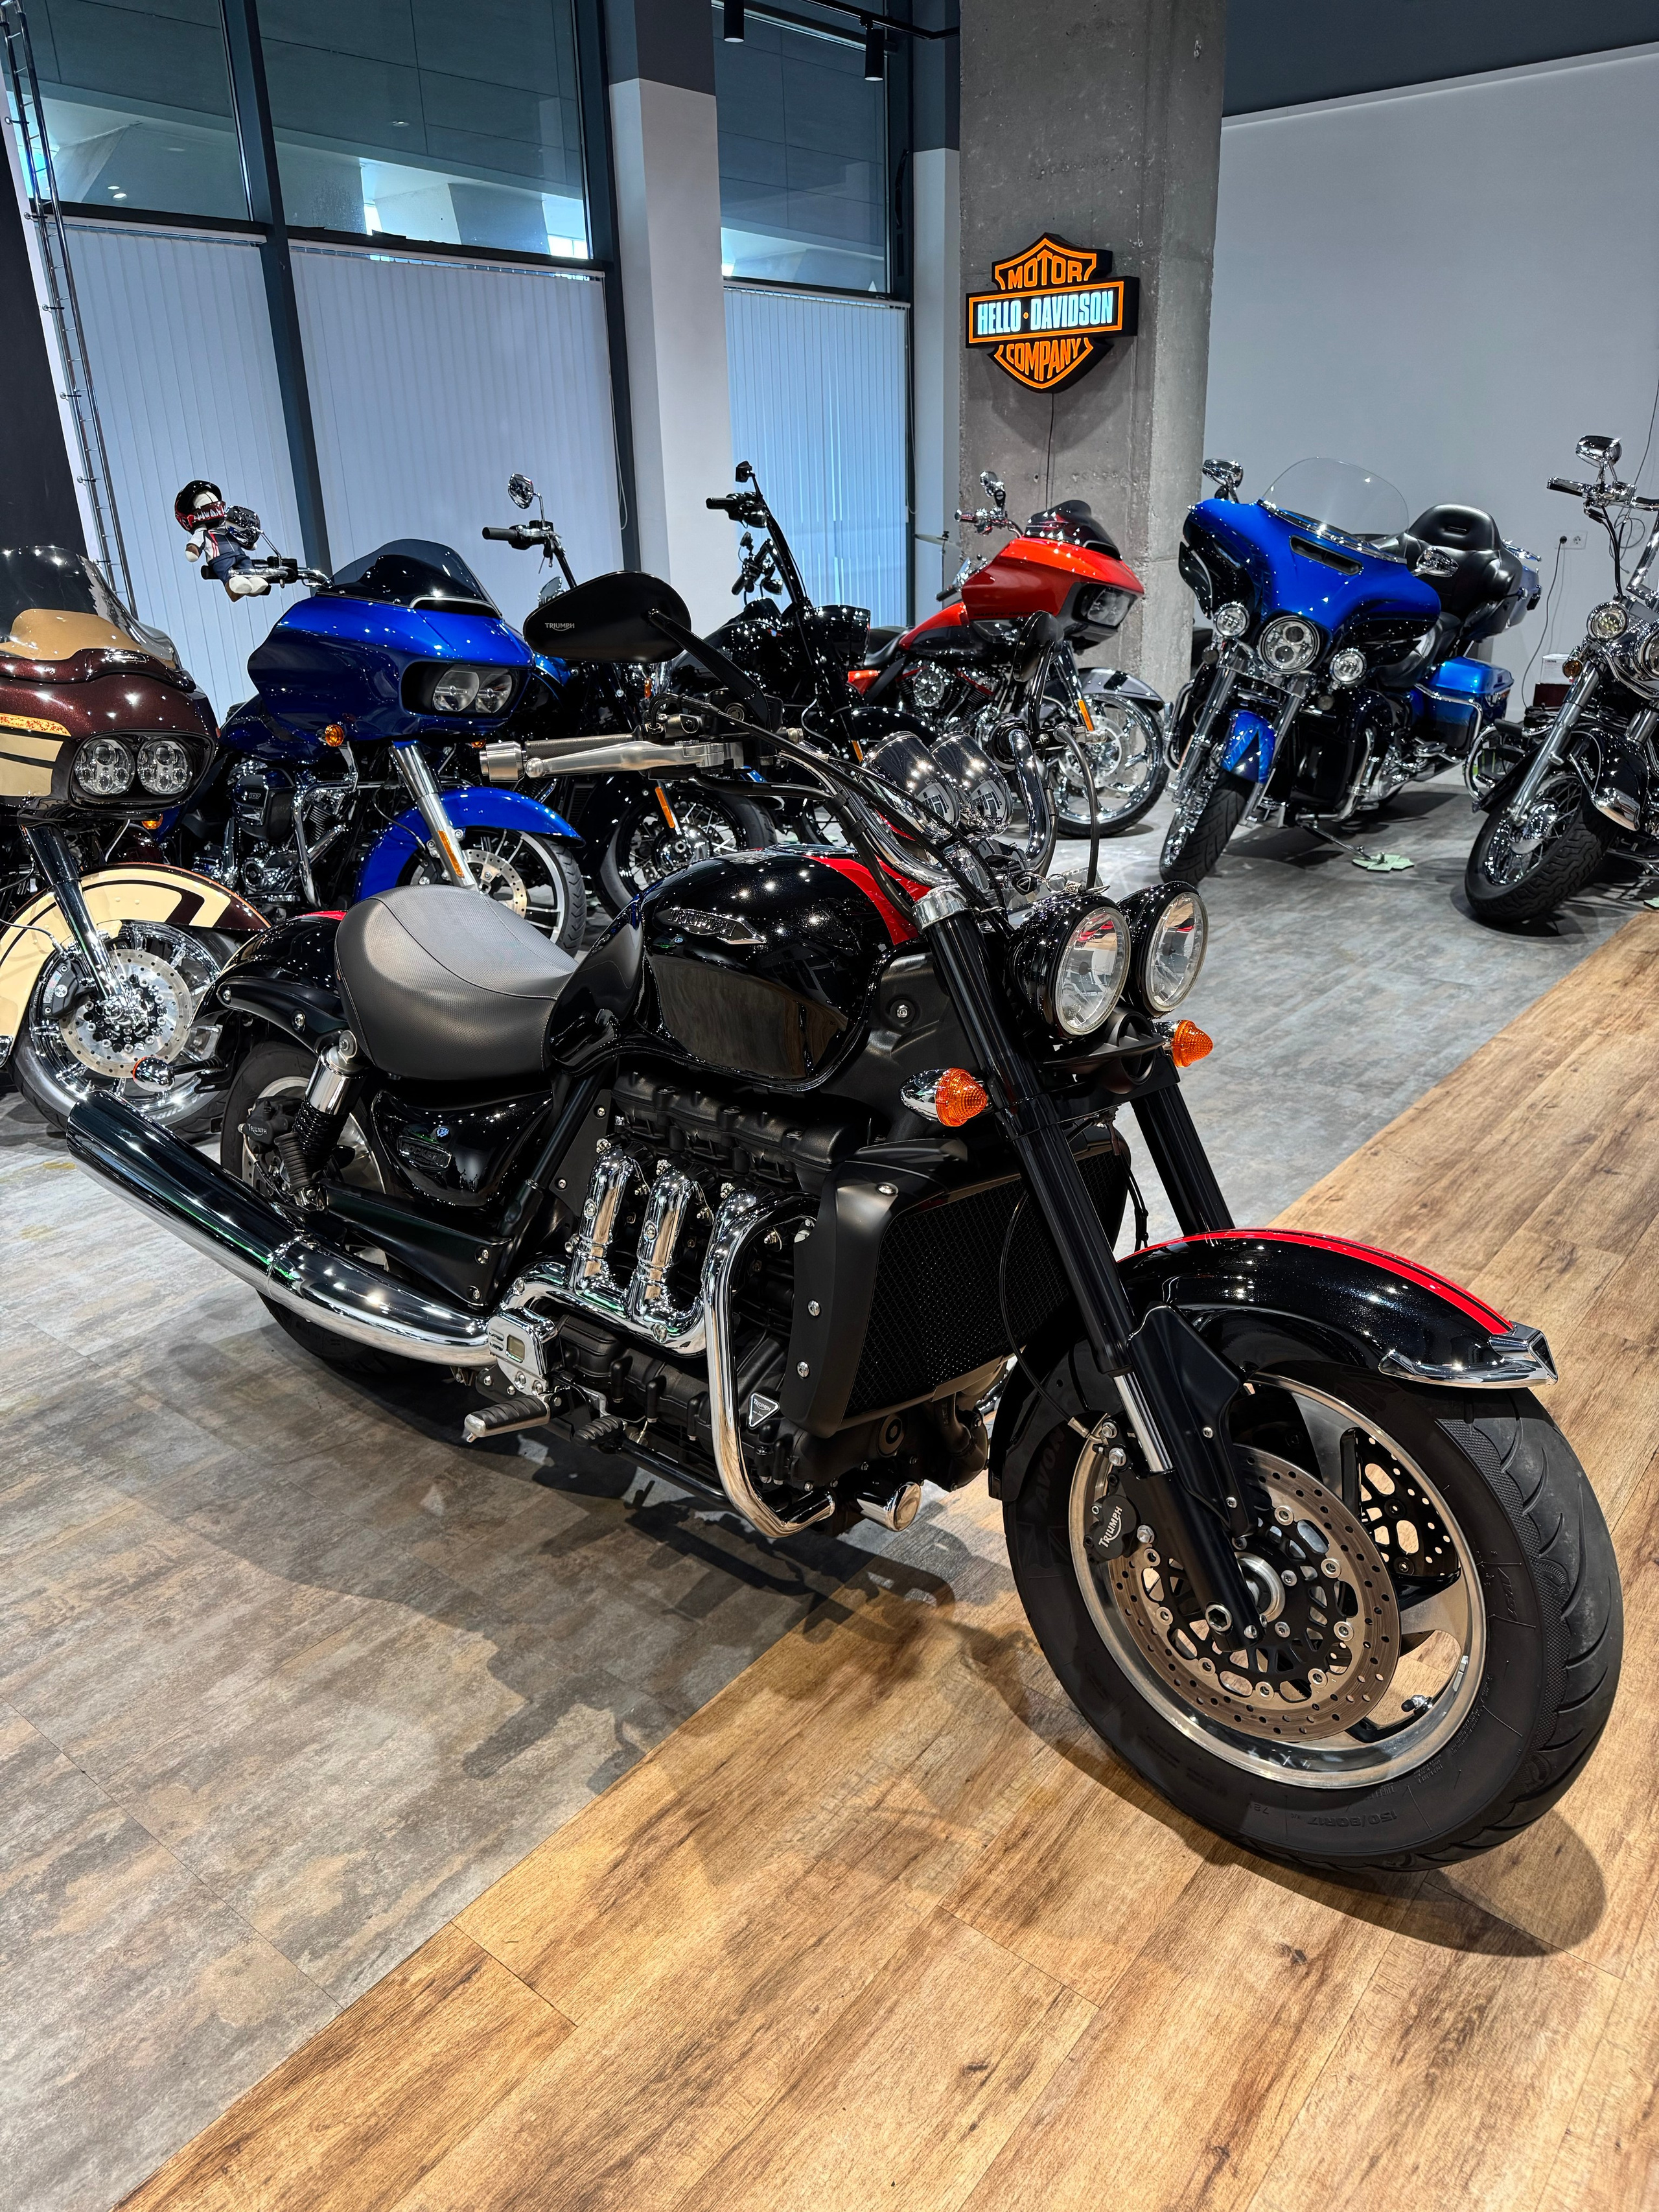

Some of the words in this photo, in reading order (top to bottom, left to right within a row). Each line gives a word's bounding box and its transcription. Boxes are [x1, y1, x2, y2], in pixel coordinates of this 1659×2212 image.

[1008, 249, 1082, 290] MOTOR
[977, 300, 1021, 335] HELLO
[1030, 290, 1113, 331] DAVIDSON
[1006, 337, 1082, 381] COMPANY
[544, 622, 575, 631] TRIUMPH
[667, 908, 736, 937] TRIUMPH
[246, 1123, 268, 1136] TRIUMPH
[753, 1398, 772, 1412] TRIUMPH
[1098, 1506, 1123, 1548] TRIUMPH
